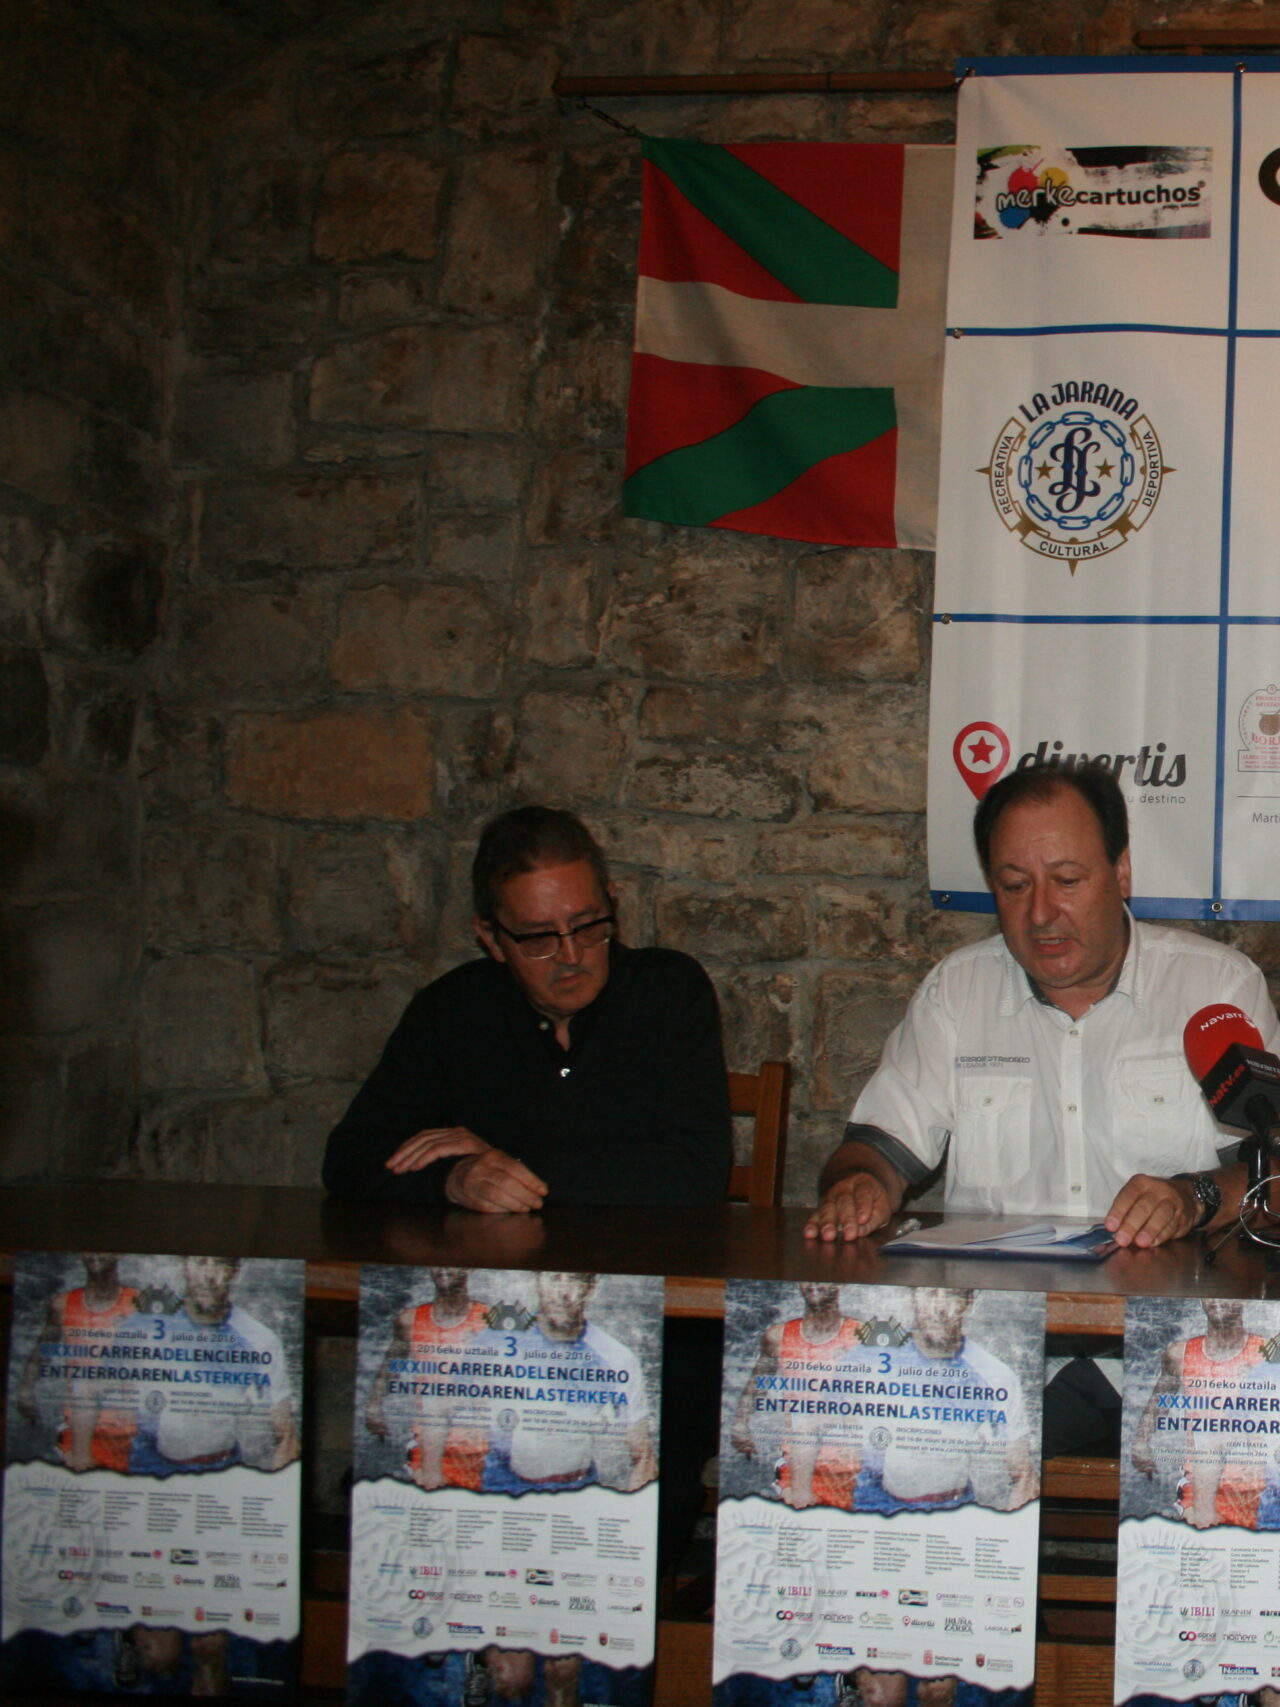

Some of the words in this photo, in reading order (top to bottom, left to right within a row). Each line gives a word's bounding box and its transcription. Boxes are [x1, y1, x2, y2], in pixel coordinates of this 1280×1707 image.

[996, 178, 1201, 212] merkecartuchos
[1019, 393, 1051, 423] LA
[1051, 381, 1139, 420] JARANA
[994, 435, 1014, 515] RECREATIVA
[1142, 430, 1159, 507] DEPORTIVA
[1039, 540, 1109, 557] CULTURAL
[1140, 794, 1185, 805] destino
[153, 1319, 166, 1340] 3
[197, 1333, 209, 1342] de
[417, 1344, 462, 1355] 2016eko
[465, 1345, 499, 1356] uztaila
[504, 1337, 518, 1357] 3
[524, 1350, 547, 1360] julio
[550, 1351, 563, 1360] de
[566, 1351, 591, 1361] 2016
[785, 1360, 833, 1372] 2016eko
[836, 1361, 872, 1374] uztaila
[878, 1353, 892, 1373] 3
[898, 1365, 922, 1377] julio
[925, 1367, 939, 1377] de
[942, 1368, 969, 1378] 2016
[1188, 1379, 1236, 1389] 2016eko
[1239, 1381, 1276, 1390] uztaila
[1191, 1607, 1215, 1616] IBILI
